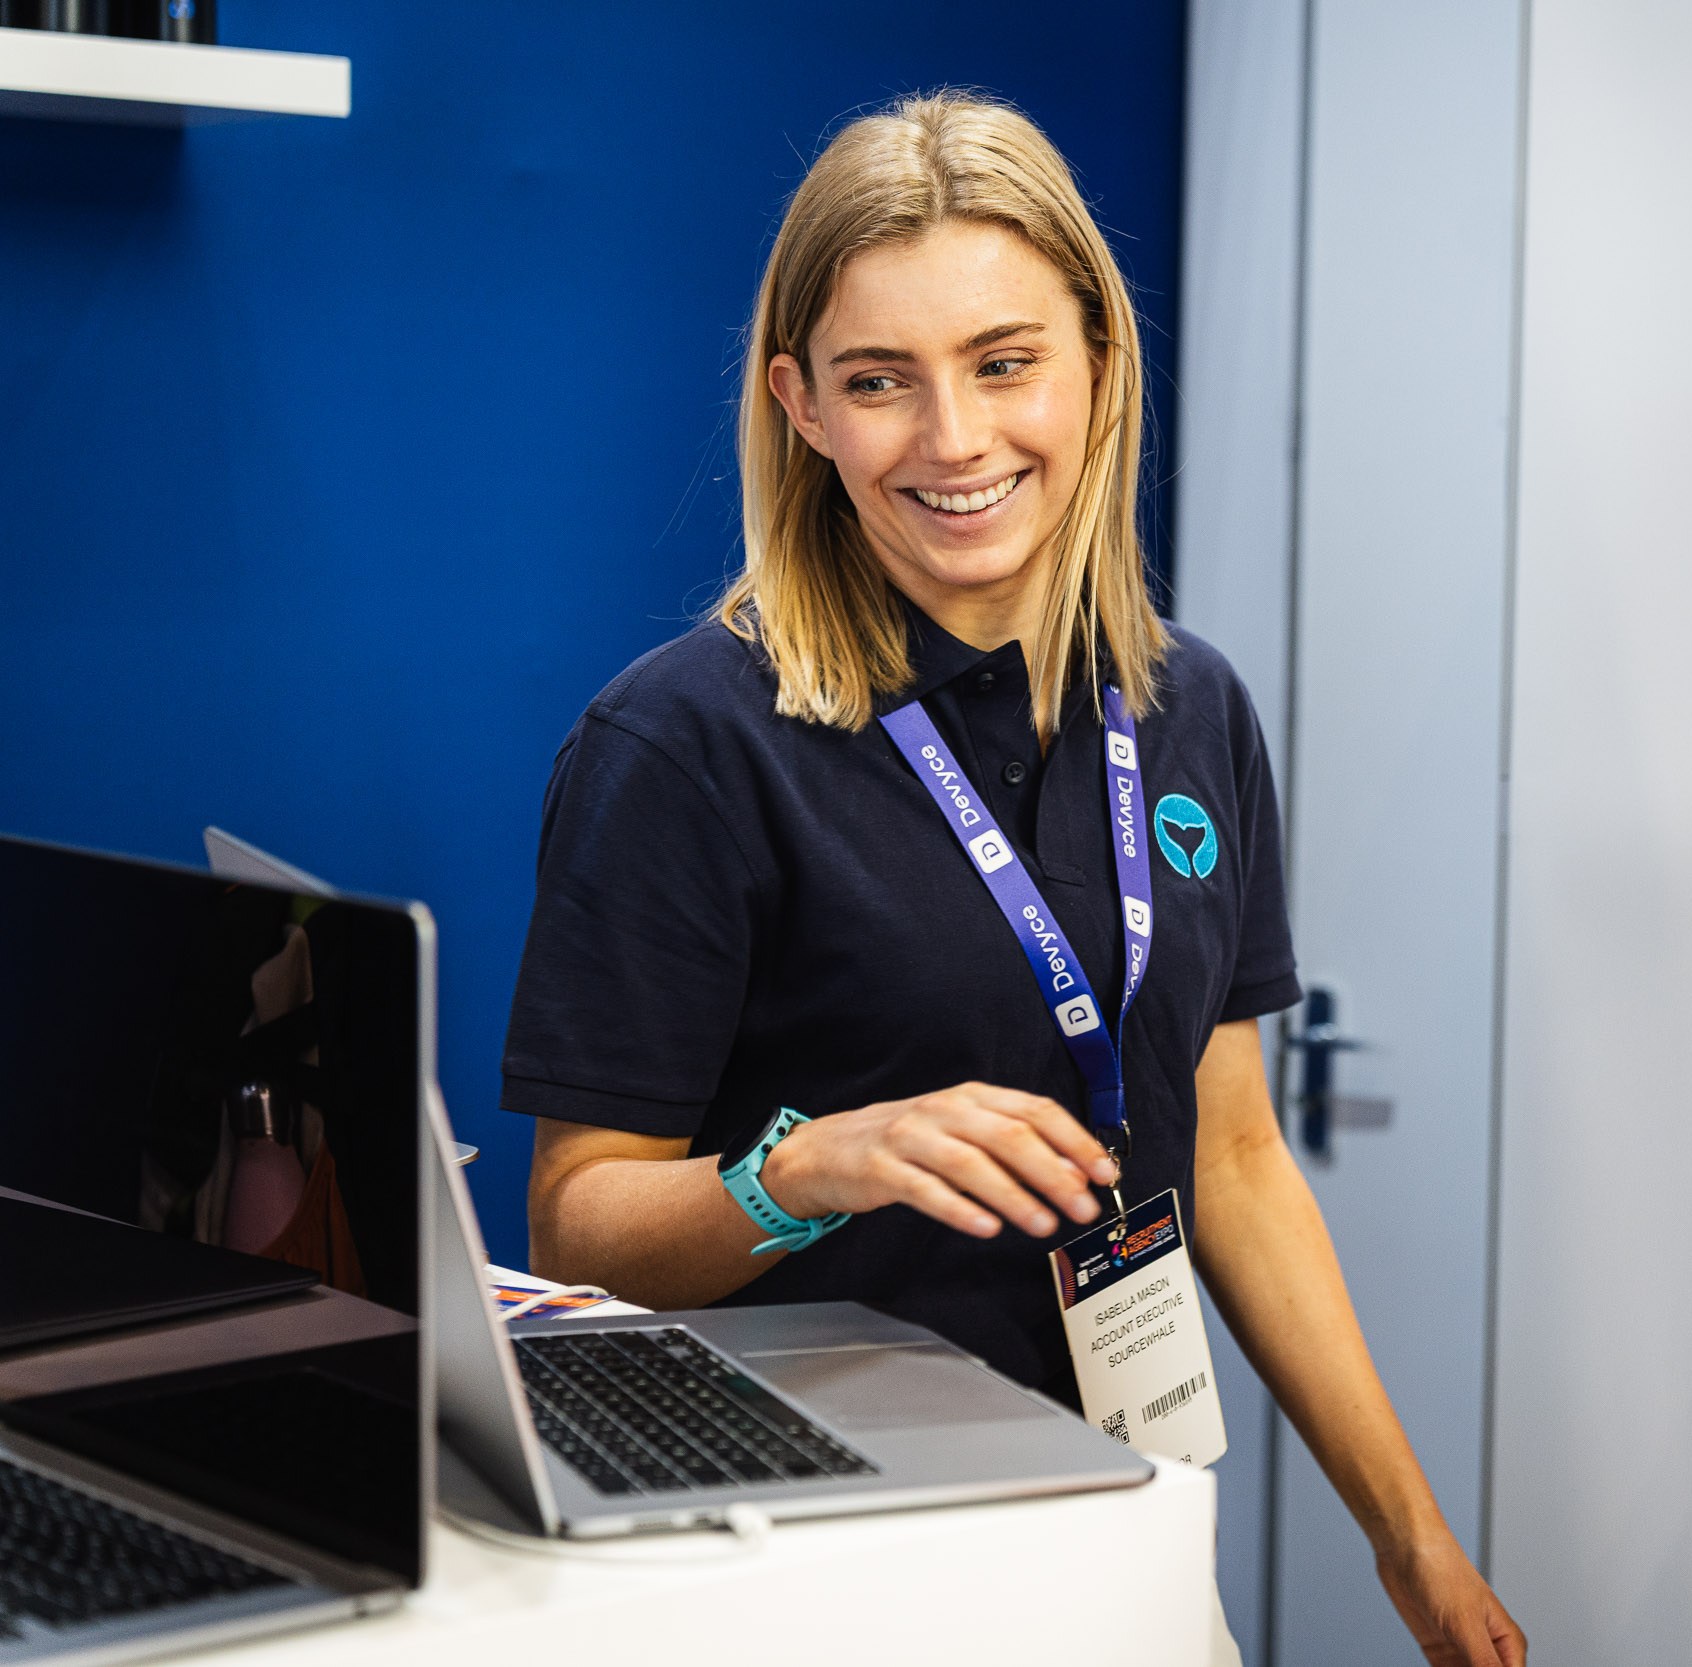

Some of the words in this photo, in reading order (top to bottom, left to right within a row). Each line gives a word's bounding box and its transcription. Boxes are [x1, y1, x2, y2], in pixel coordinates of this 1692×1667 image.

[921, 744, 982, 828] Devyce
[1117, 776, 1137, 859] Devyce
[1022, 904, 1075, 992] Devyce
[1091, 1319, 1135, 1354] ACCOUNT
[1136, 1292, 1184, 1328] EXECUTIVE
[1095, 1296, 1137, 1326] ISABELLA
[1137, 1276, 1170, 1302] MASON
[1108, 1321, 1175, 1368] SOURCEWHALE
